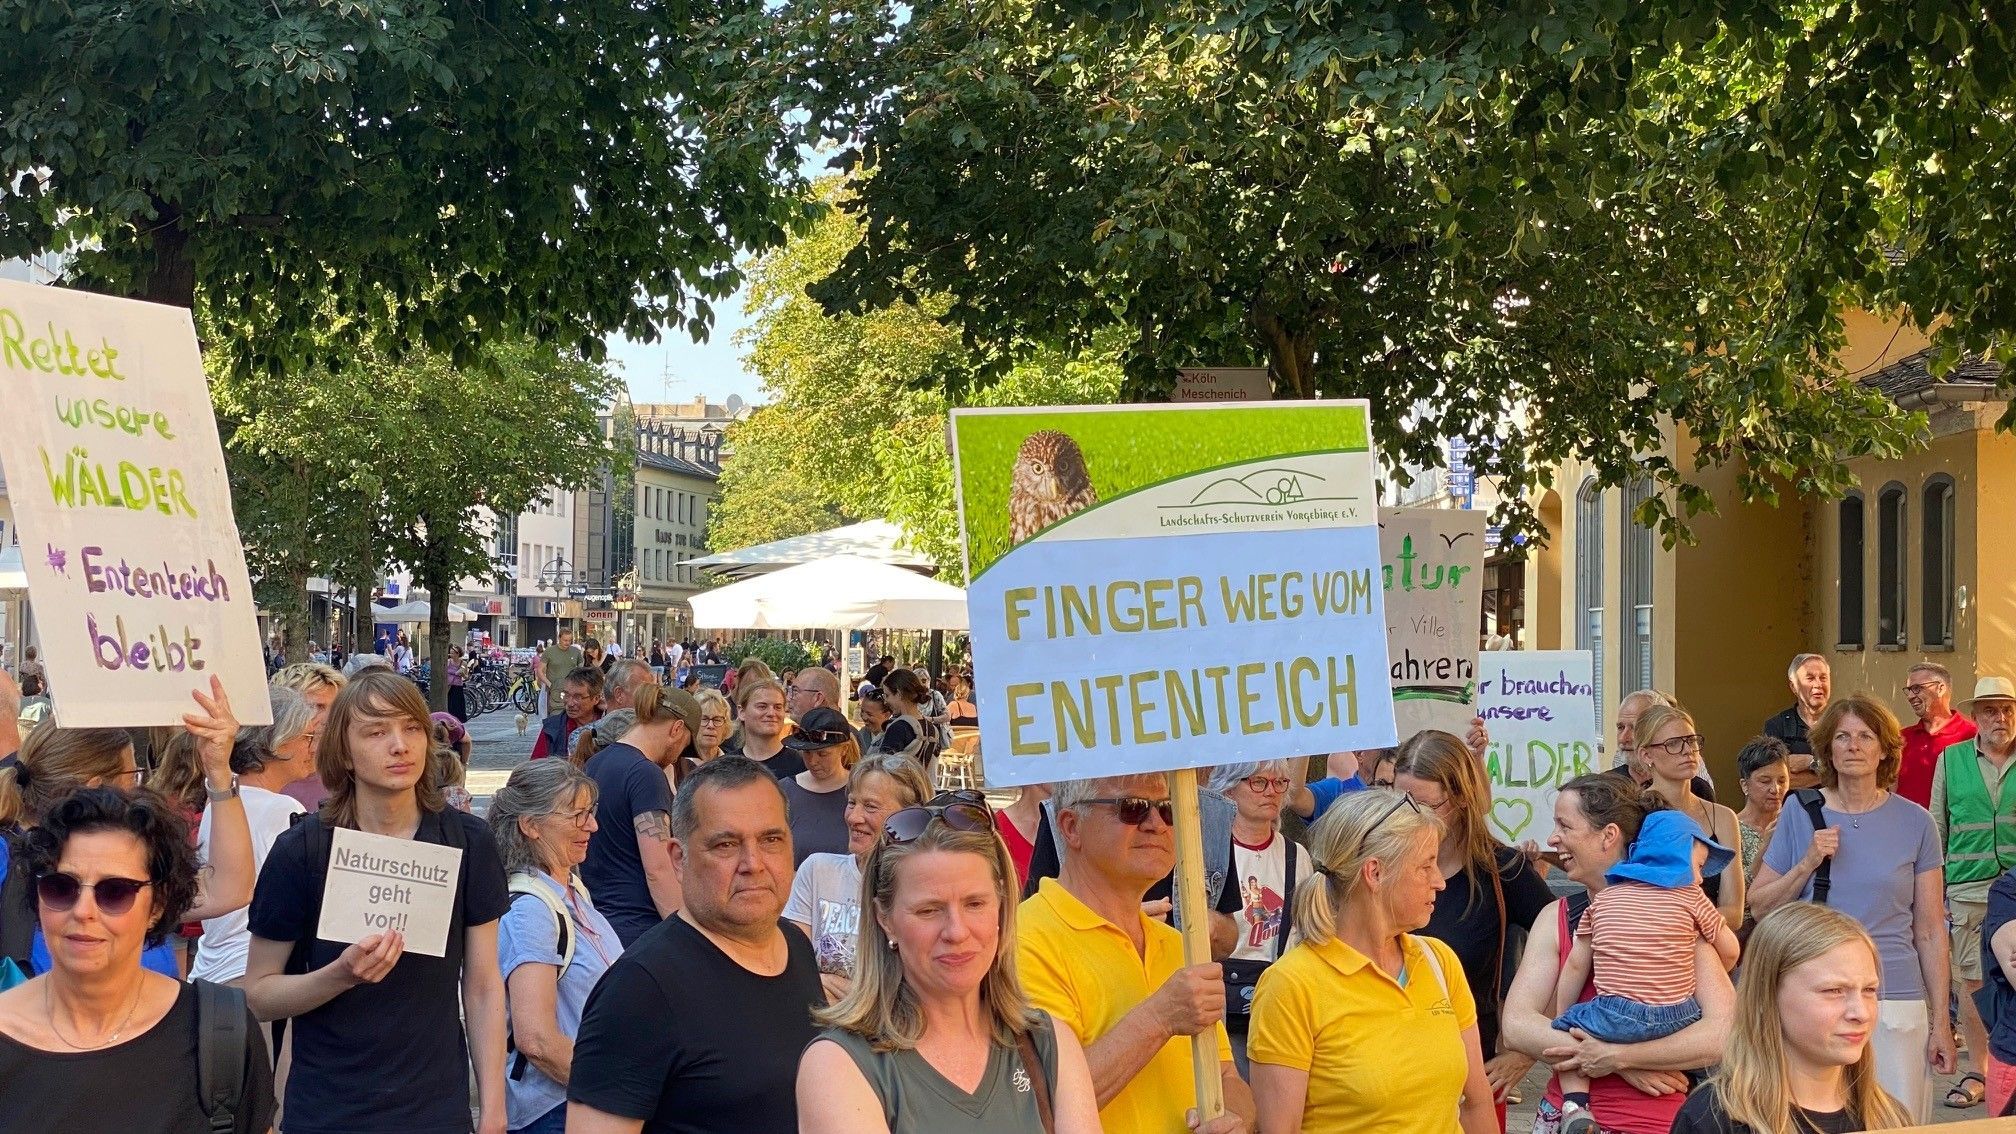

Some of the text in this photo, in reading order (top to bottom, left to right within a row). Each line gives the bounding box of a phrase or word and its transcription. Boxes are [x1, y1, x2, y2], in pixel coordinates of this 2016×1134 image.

[1, 308, 125, 381] Rettet
[1181, 388, 1247, 399] Meschenich
[1192, 373, 1217, 384] Köln
[55, 395, 176, 441] unsere
[38, 445, 198, 520] WÄLDER
[1004, 568, 1373, 641] FINGER WEG VOM
[86, 612, 206, 673] bleibt
[1410, 614, 1446, 638] Ville
[1391, 648, 1473, 681] ahren
[1006, 654, 1359, 757] ENTENTEICH
[1486, 740, 1593, 789] ÄLDER
[335, 847, 449, 883] Naturschutz
[369, 884, 412, 904] geht
[364, 912, 408, 932] vor!!
